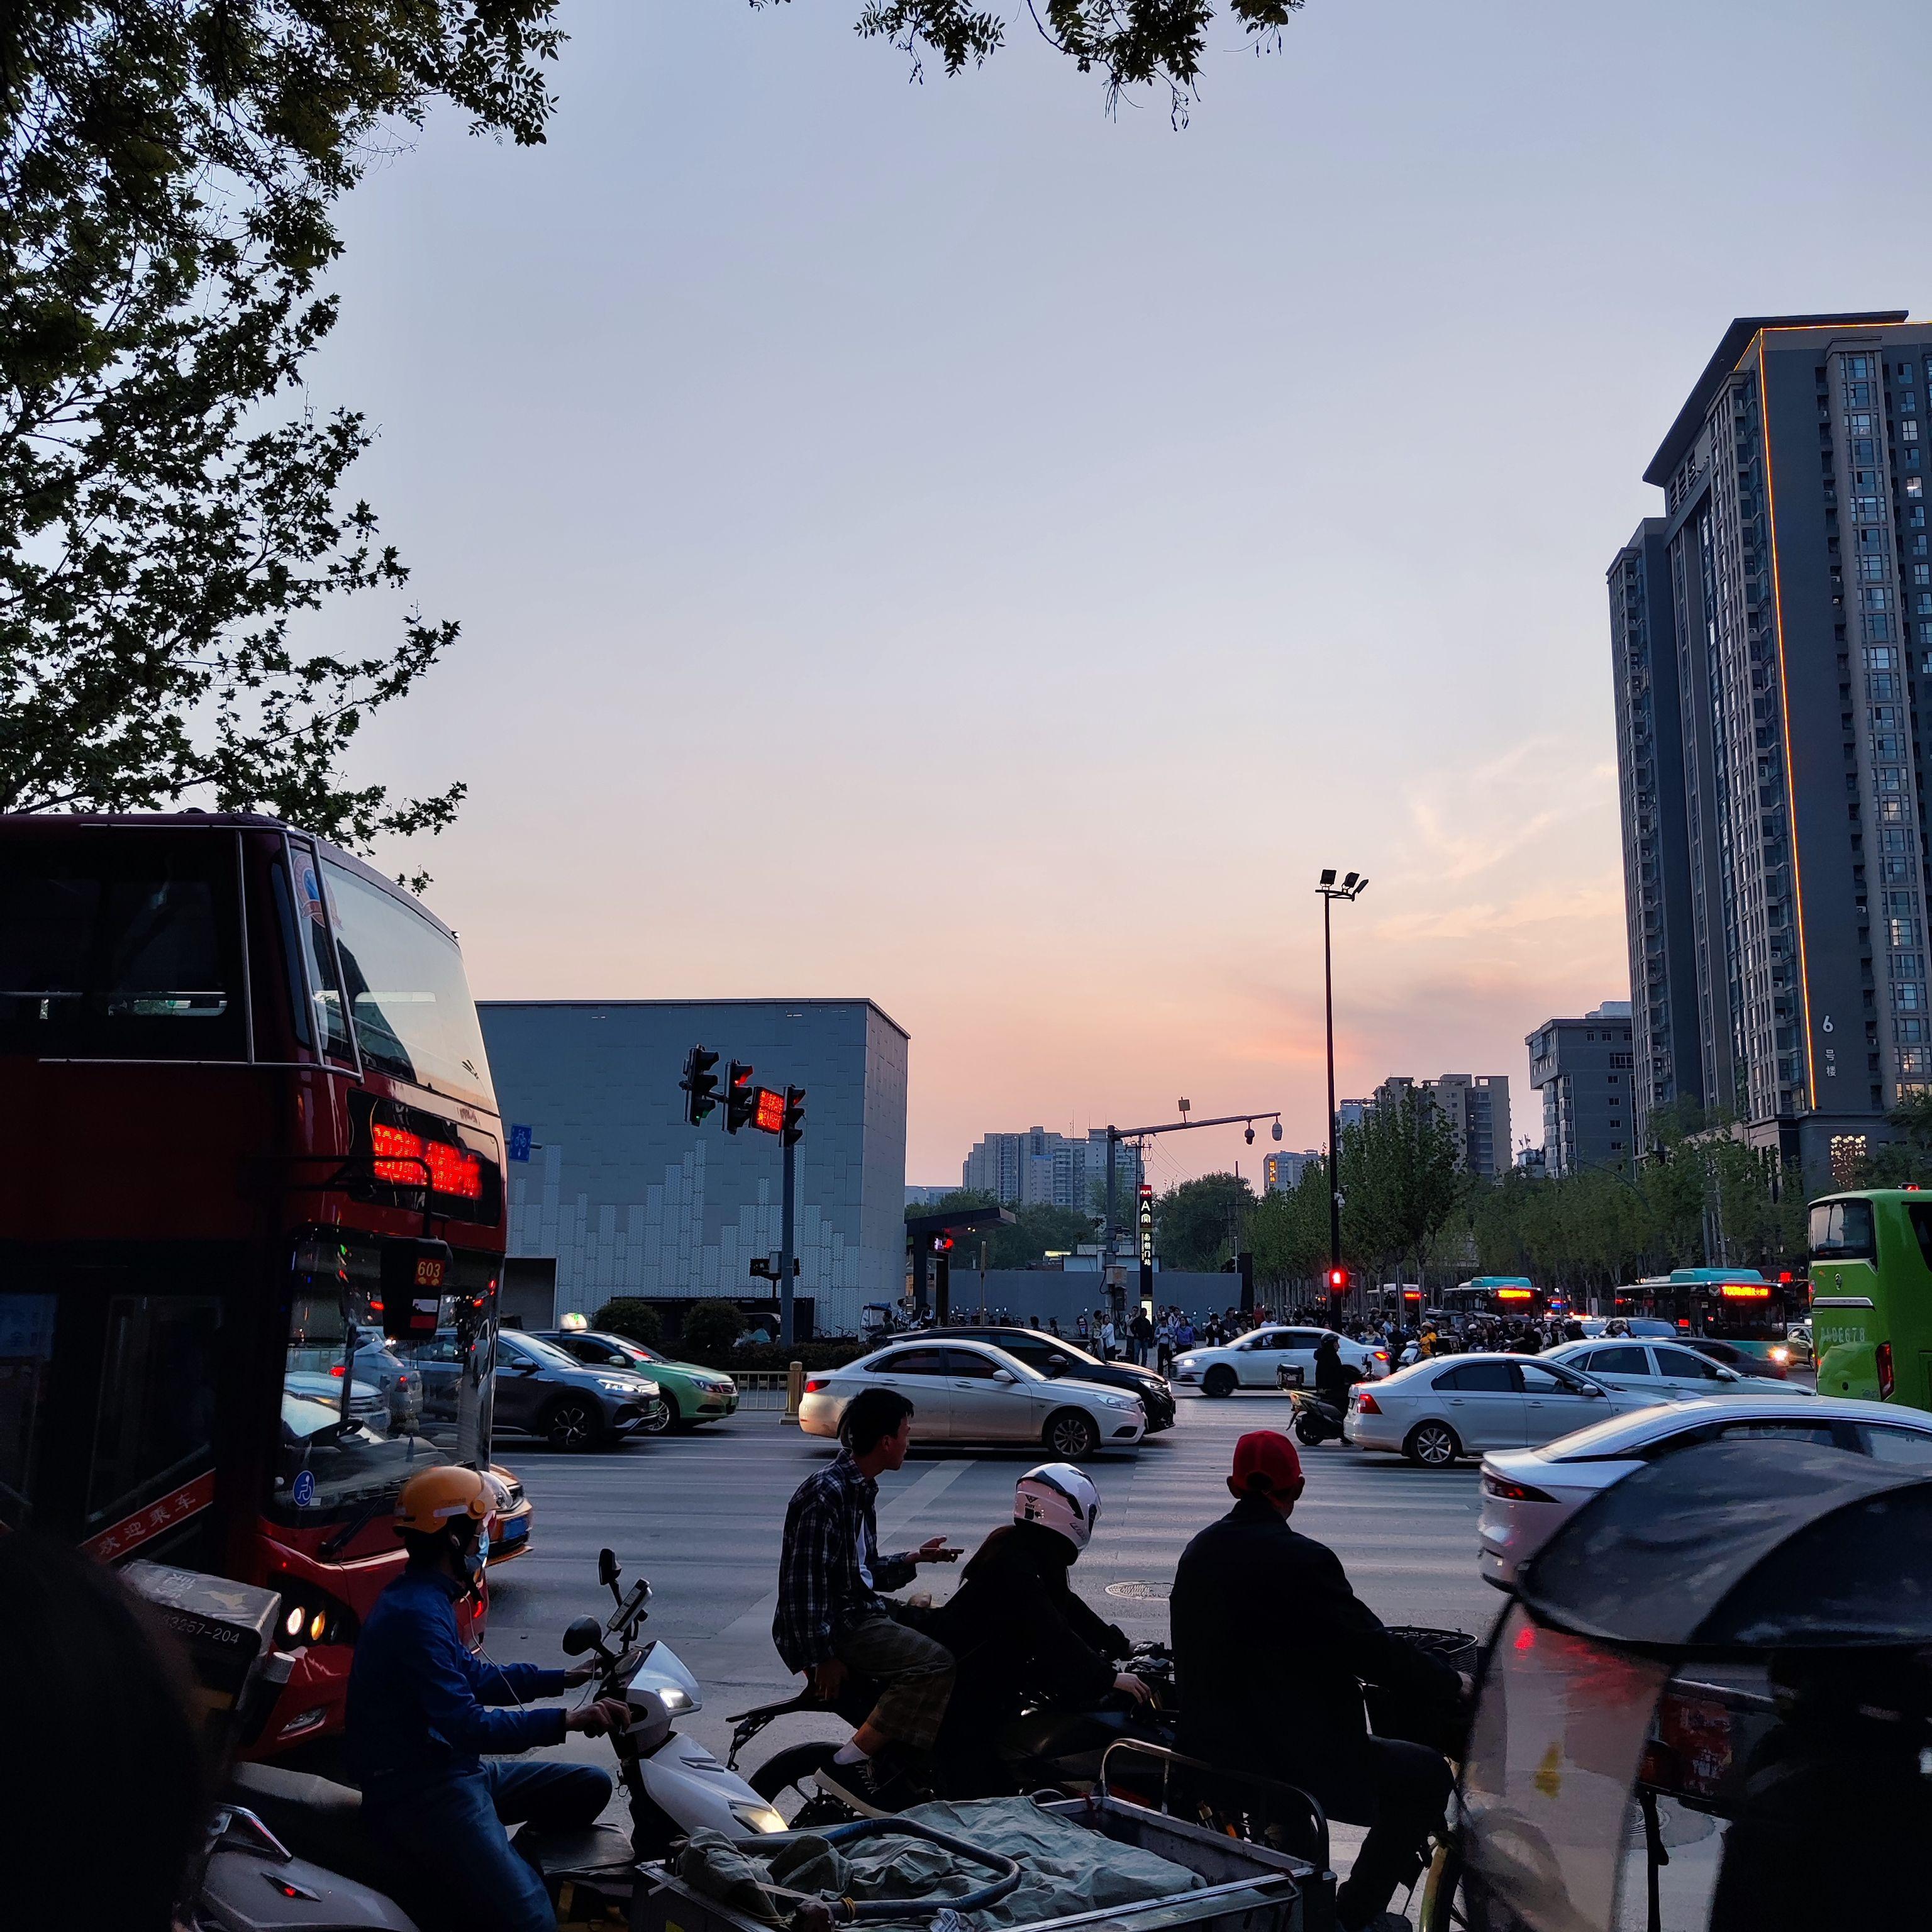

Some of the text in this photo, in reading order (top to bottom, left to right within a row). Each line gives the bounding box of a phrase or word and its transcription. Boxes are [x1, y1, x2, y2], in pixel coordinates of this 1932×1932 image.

[1823, 1015, 1836, 1077] 6号楼
[1140, 1200, 1151, 1211] A
[418, 1261, 441, 1278] 603
[99, 1491, 197, 1556] 欢迎乘车
